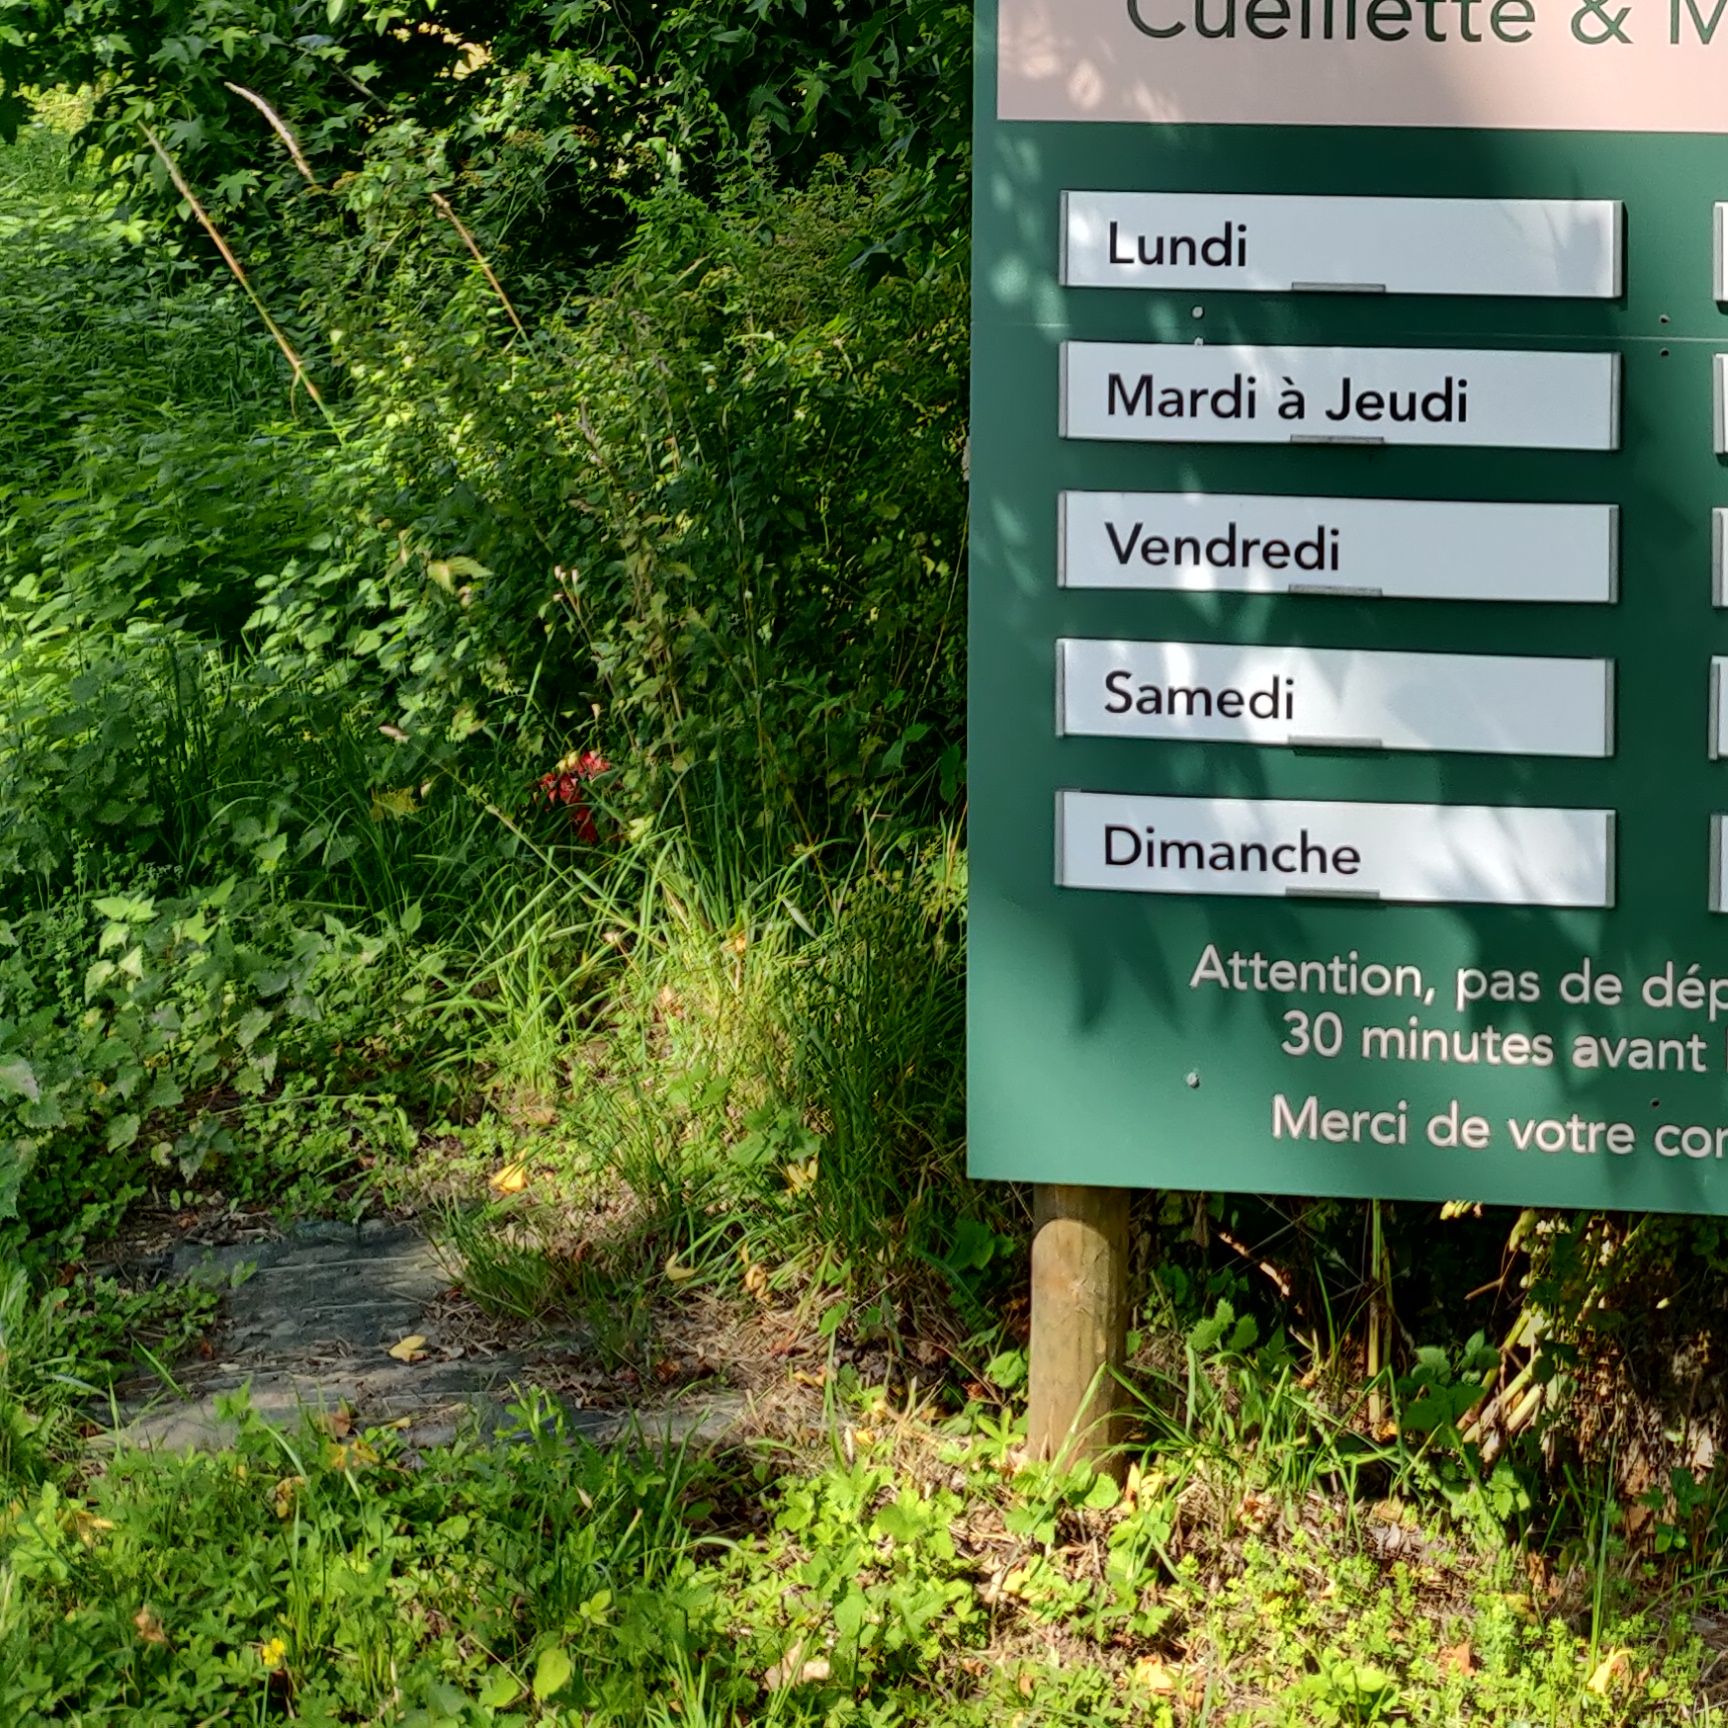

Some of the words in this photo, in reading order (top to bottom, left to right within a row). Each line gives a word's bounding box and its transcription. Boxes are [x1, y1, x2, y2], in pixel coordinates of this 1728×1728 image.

[1110, 221, 1246, 266] Lundi
[1109, 374, 1255, 418] Mardi
[1278, 377, 1304, 419] à
[1326, 377, 1467, 422] Jeudi
[1105, 523, 1339, 570] Vendredi
[1105, 671, 1293, 719] Samedi
[1105, 825, 1360, 874] Dimanche
[1190, 945, 1435, 1006] Attention,
[1455, 968, 1539, 1013] pas
[1560, 958, 1622, 1005] de
[1282, 1010, 1342, 1056] 30
[1363, 1016, 1553, 1066] minutes
[1572, 1035, 1706, 1072] avant
[1273, 1095, 1406, 1144] Merci
[1428, 1100, 1490, 1148] de
[1508, 1115, 1634, 1153] votre
